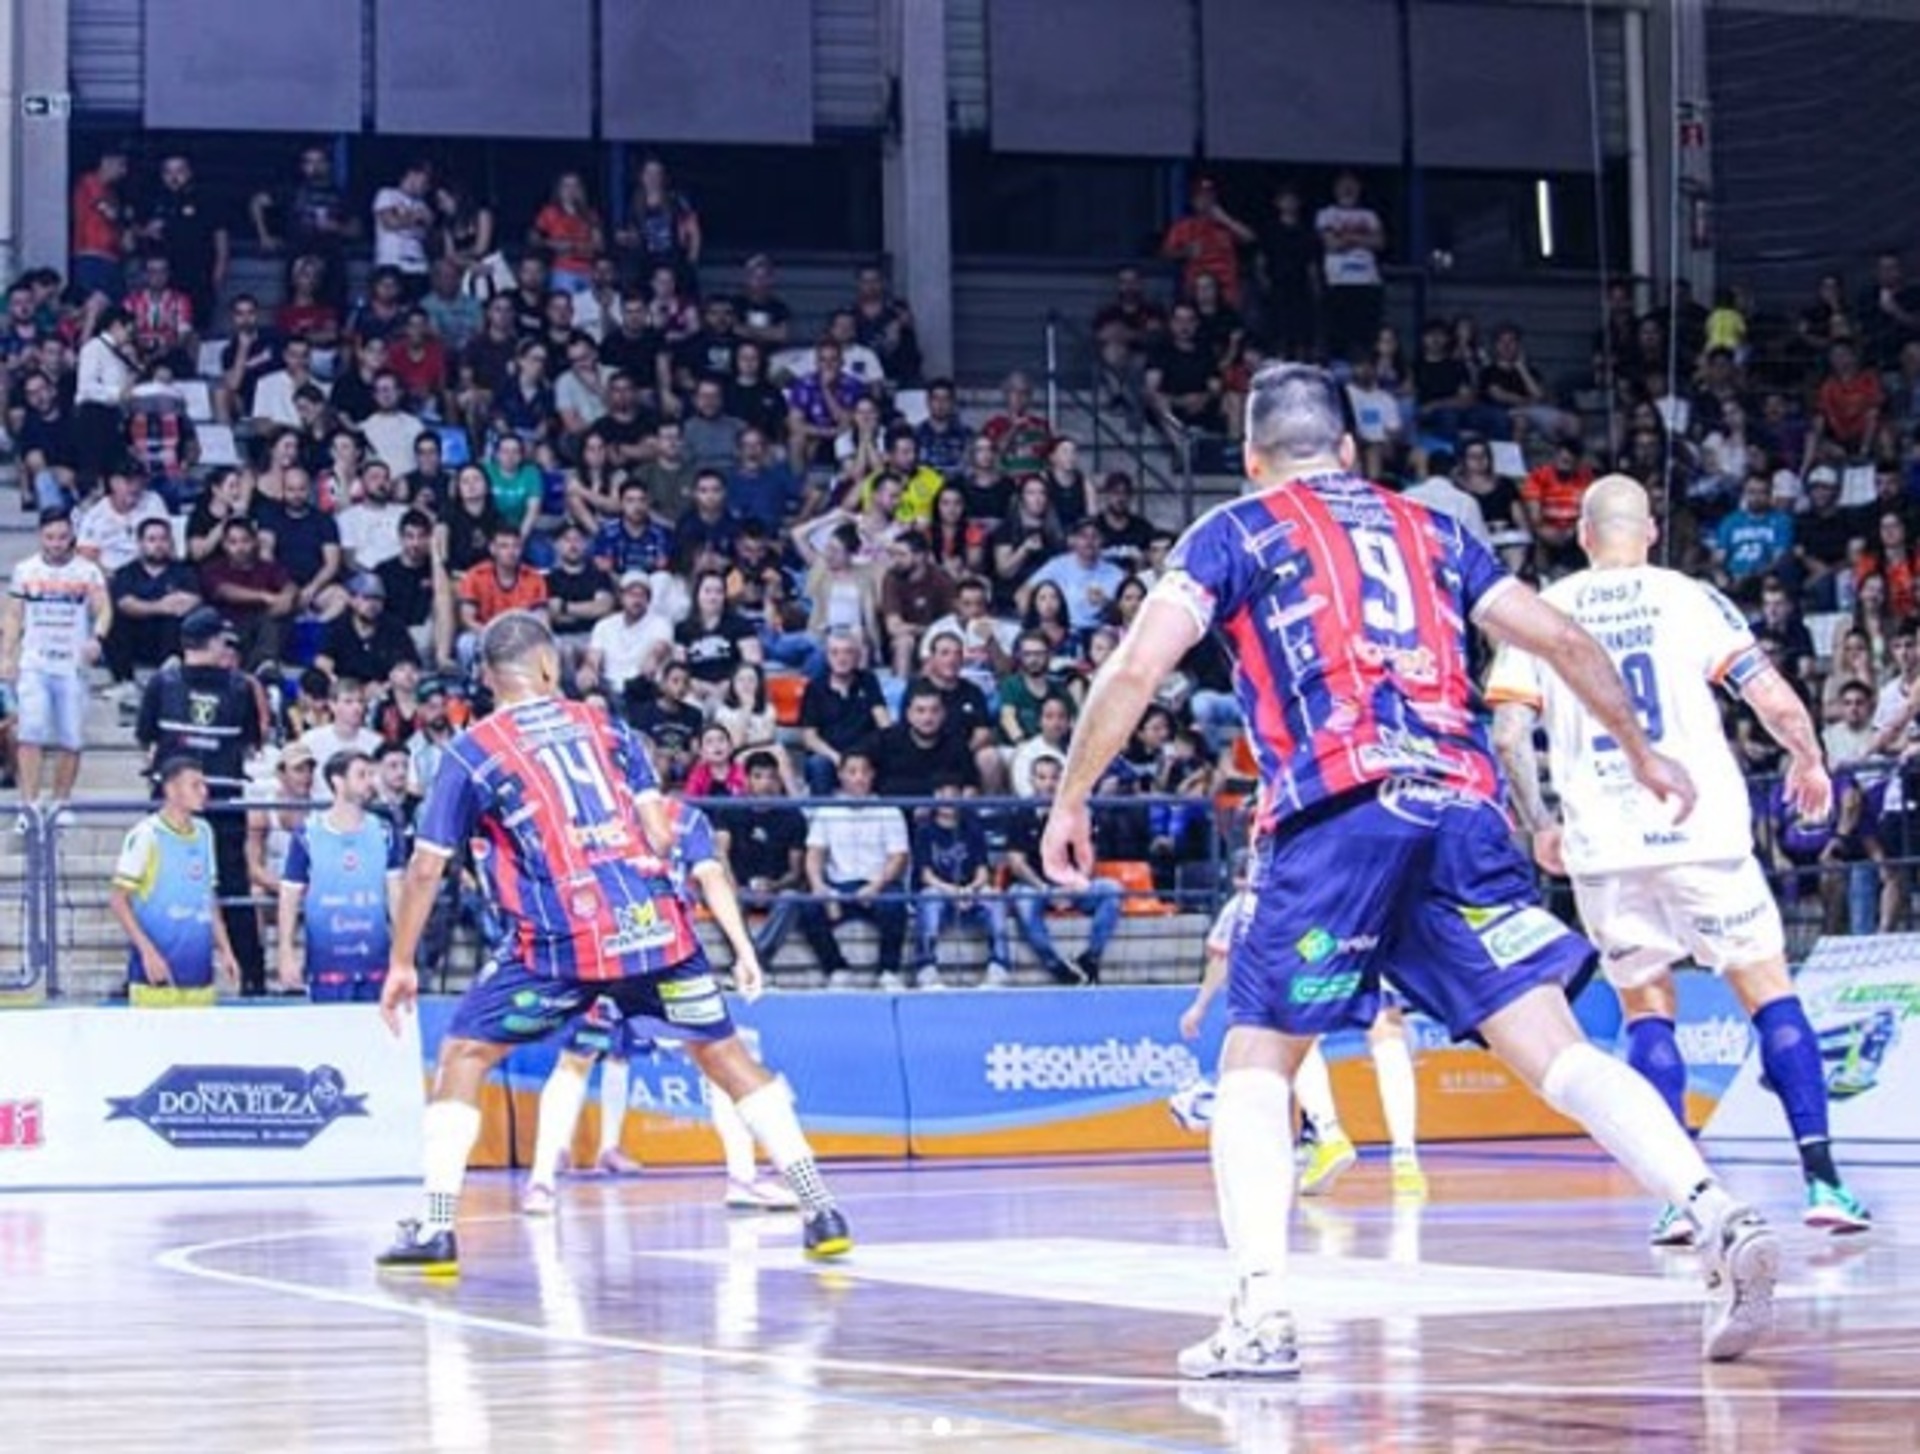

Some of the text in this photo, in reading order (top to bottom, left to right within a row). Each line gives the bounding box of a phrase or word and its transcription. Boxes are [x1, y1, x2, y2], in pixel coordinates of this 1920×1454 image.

[1351, 529, 1416, 634] 9
[536, 741, 617, 818] 14
[158, 1091, 318, 1114] DONA ELZA
